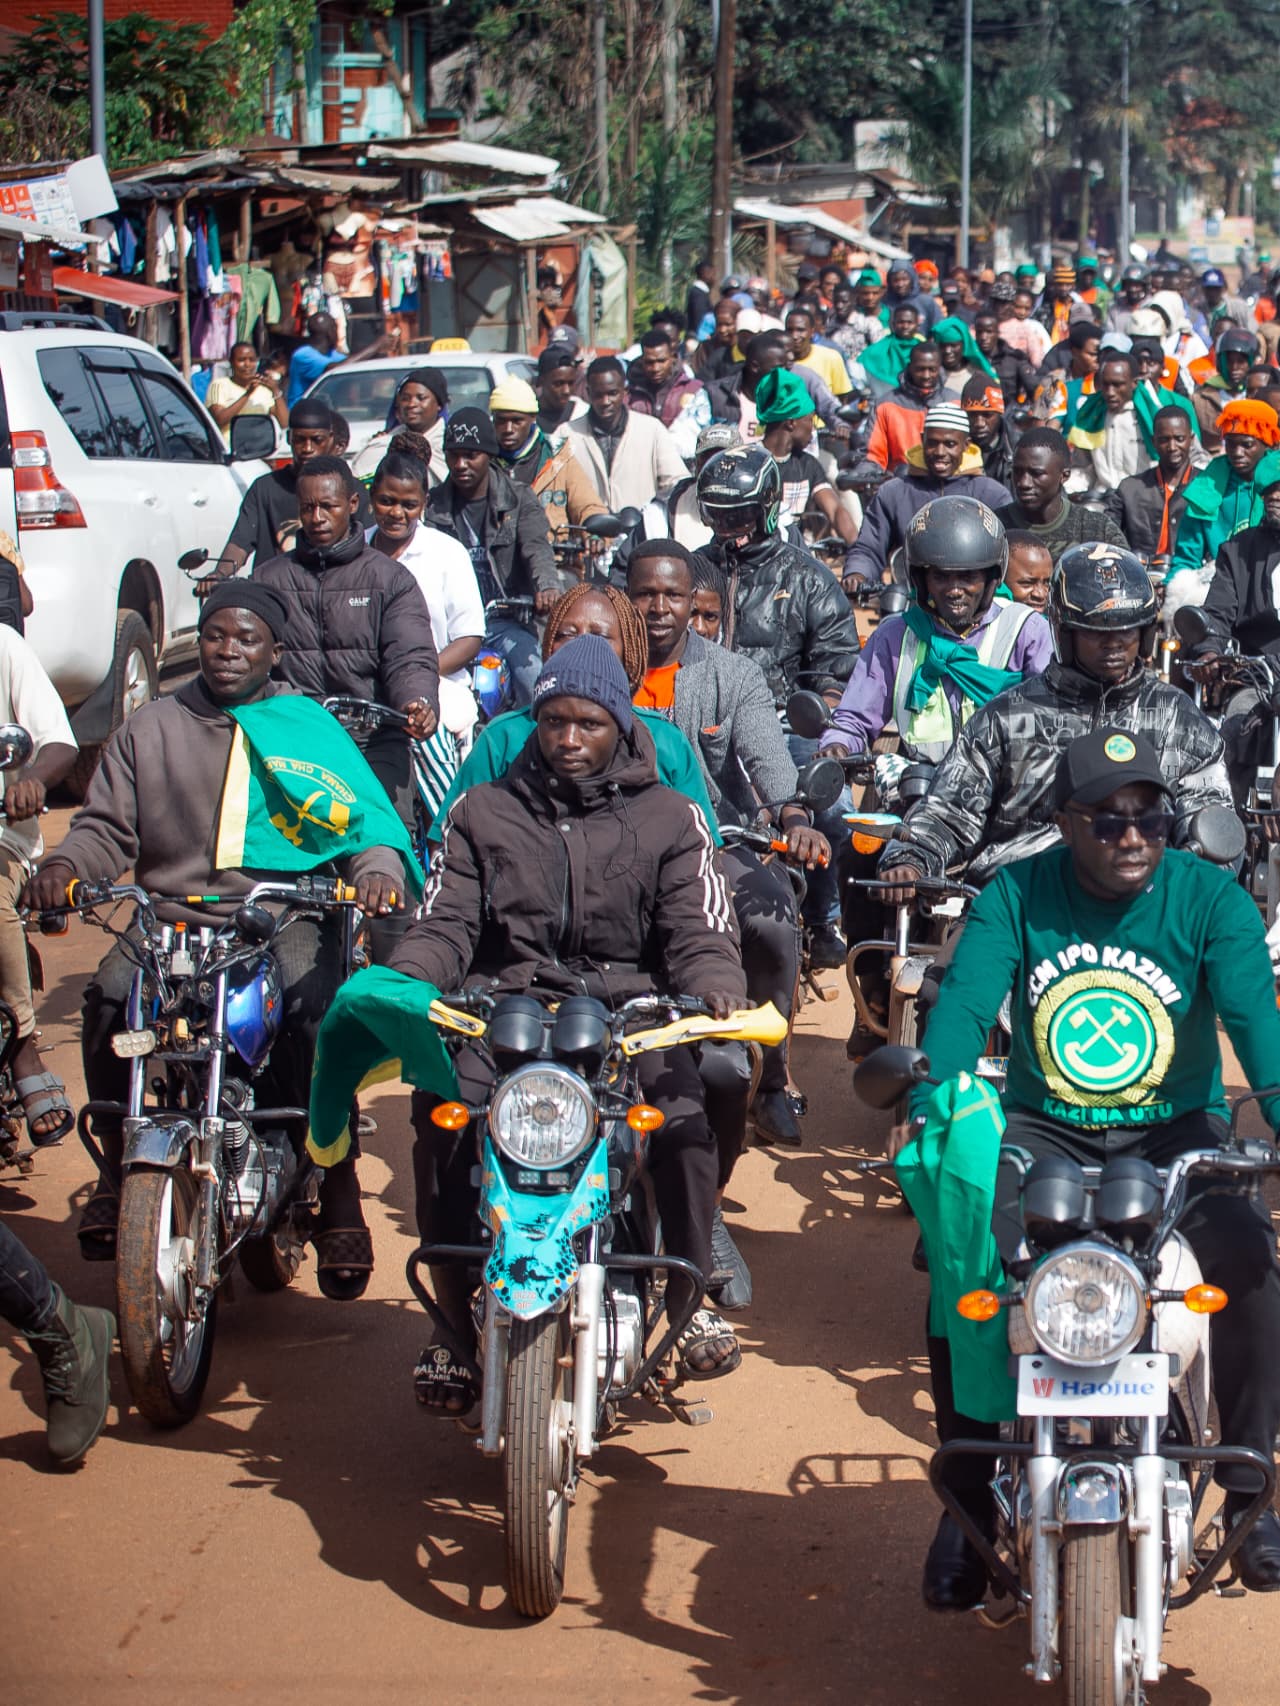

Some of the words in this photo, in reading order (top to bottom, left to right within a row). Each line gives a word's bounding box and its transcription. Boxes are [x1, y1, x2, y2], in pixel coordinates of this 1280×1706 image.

[290, 760, 314, 774] CHA
[1028, 959, 1059, 1007] CCM
[1057, 943, 1099, 971] IPO
[1102, 946, 1182, 1005] KAZINI
[1043, 1097, 1087, 1122] KAZI
[1092, 1107, 1125, 1122] NA
[1128, 1103, 1173, 1121] UTU
[1061, 1380, 1155, 1396] Haojue
